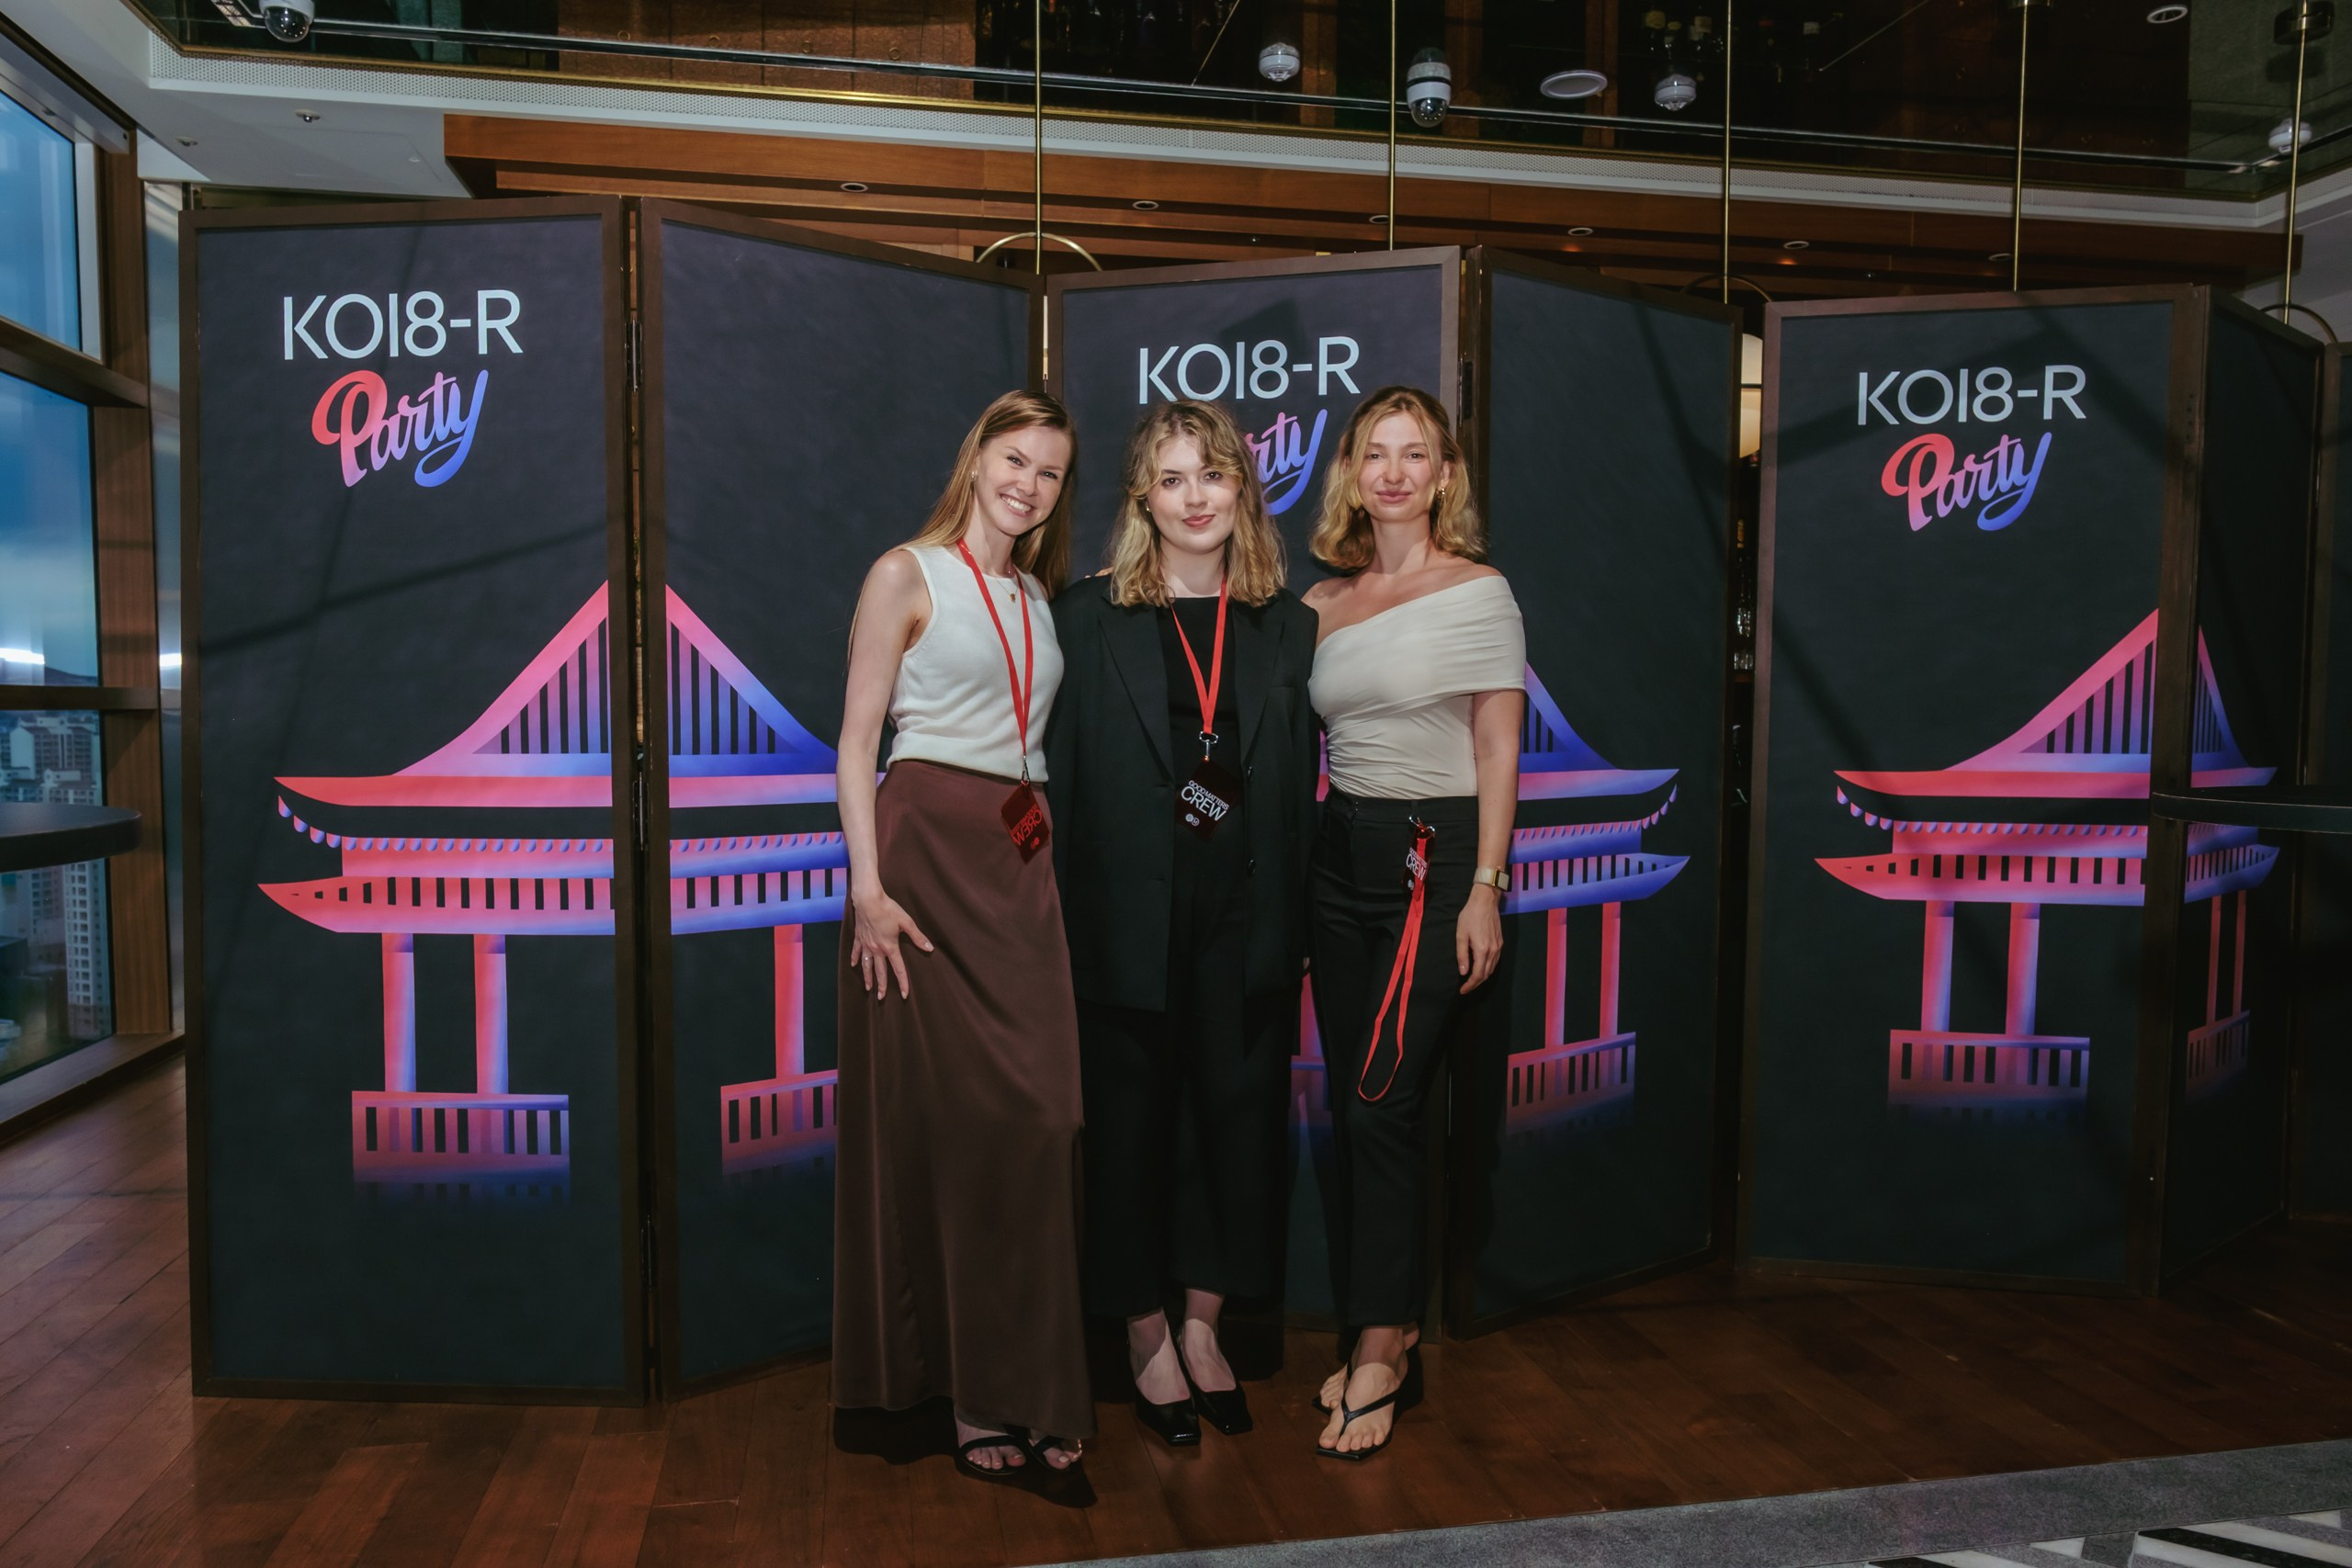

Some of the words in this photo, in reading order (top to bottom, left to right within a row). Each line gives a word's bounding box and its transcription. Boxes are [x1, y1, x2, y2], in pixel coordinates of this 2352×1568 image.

[311, 369, 489, 488] Party
[1244, 409, 1328, 516] rty
[1881, 432, 2052, 532] Party
[1181, 785, 1227, 821] CREW
[1204, 790, 1229, 810] MATTERS
[1406, 853, 1427, 881] CREW
